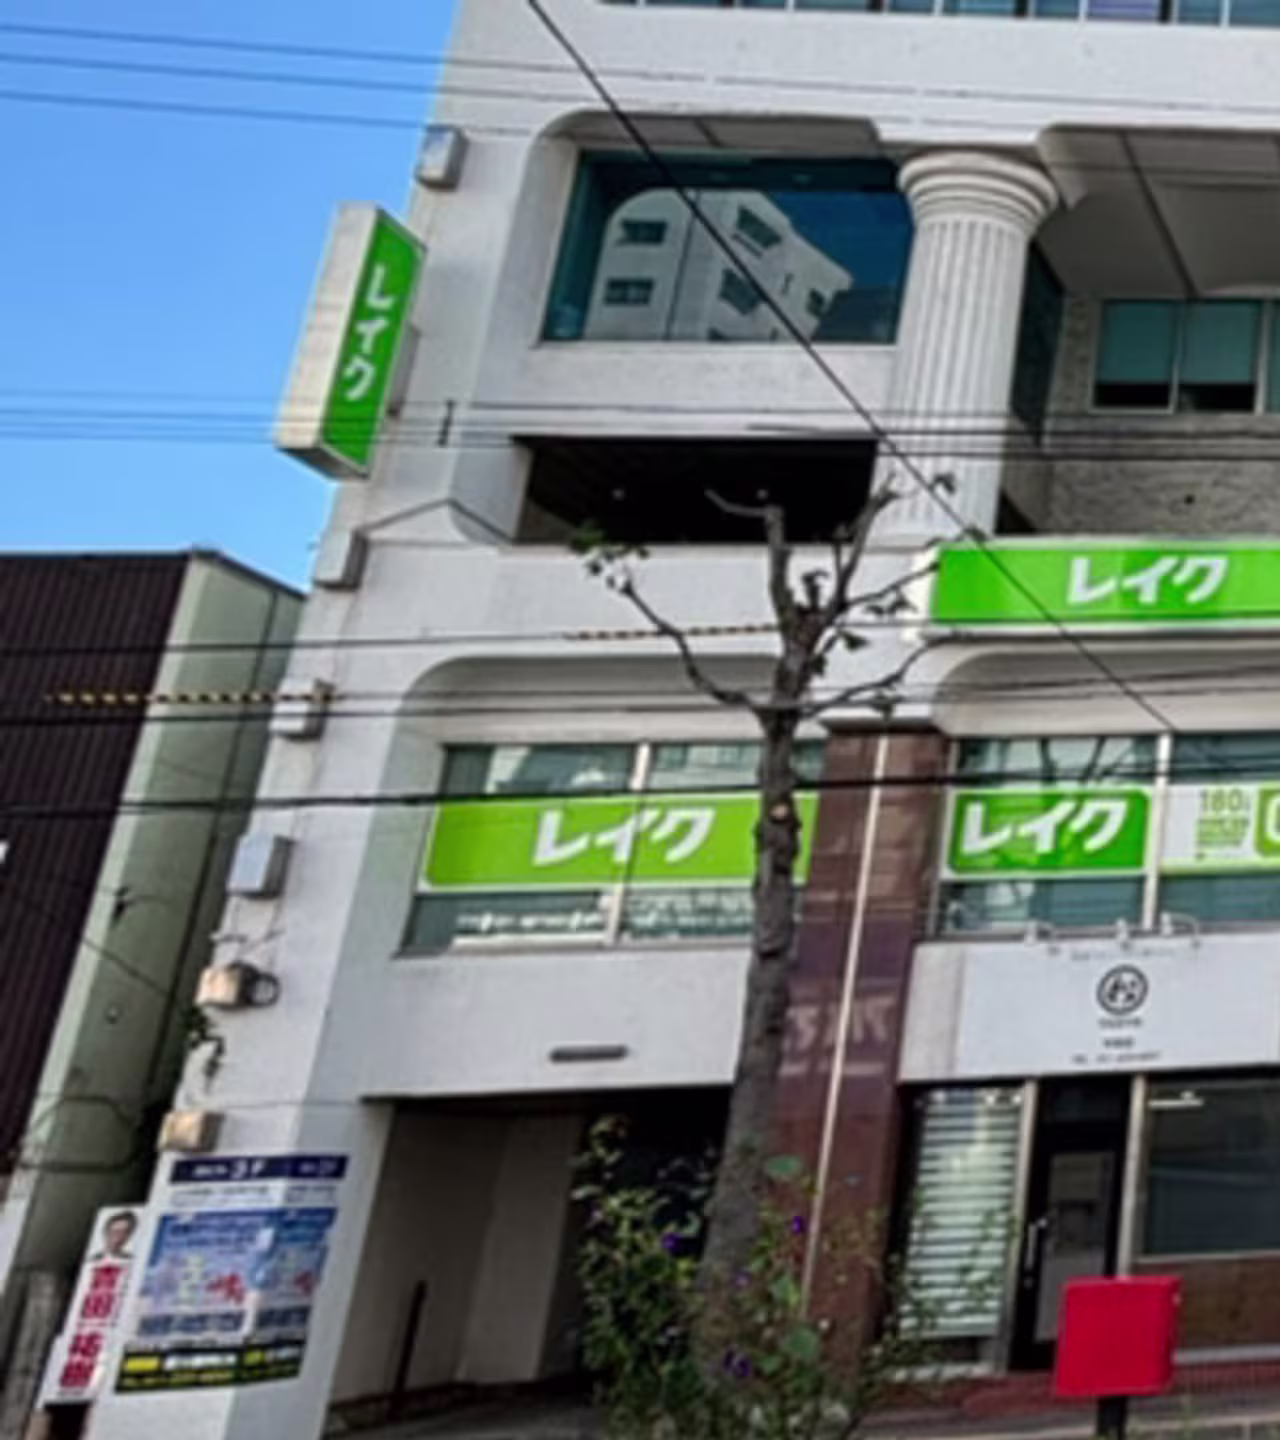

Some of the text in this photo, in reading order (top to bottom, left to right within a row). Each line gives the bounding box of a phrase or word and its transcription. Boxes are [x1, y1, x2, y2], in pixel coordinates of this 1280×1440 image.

[343, 262, 396, 402] レイク
[1066, 555, 1229, 605] レイク
[532, 808, 716, 866] レイク
[960, 800, 1128, 854] レイク
